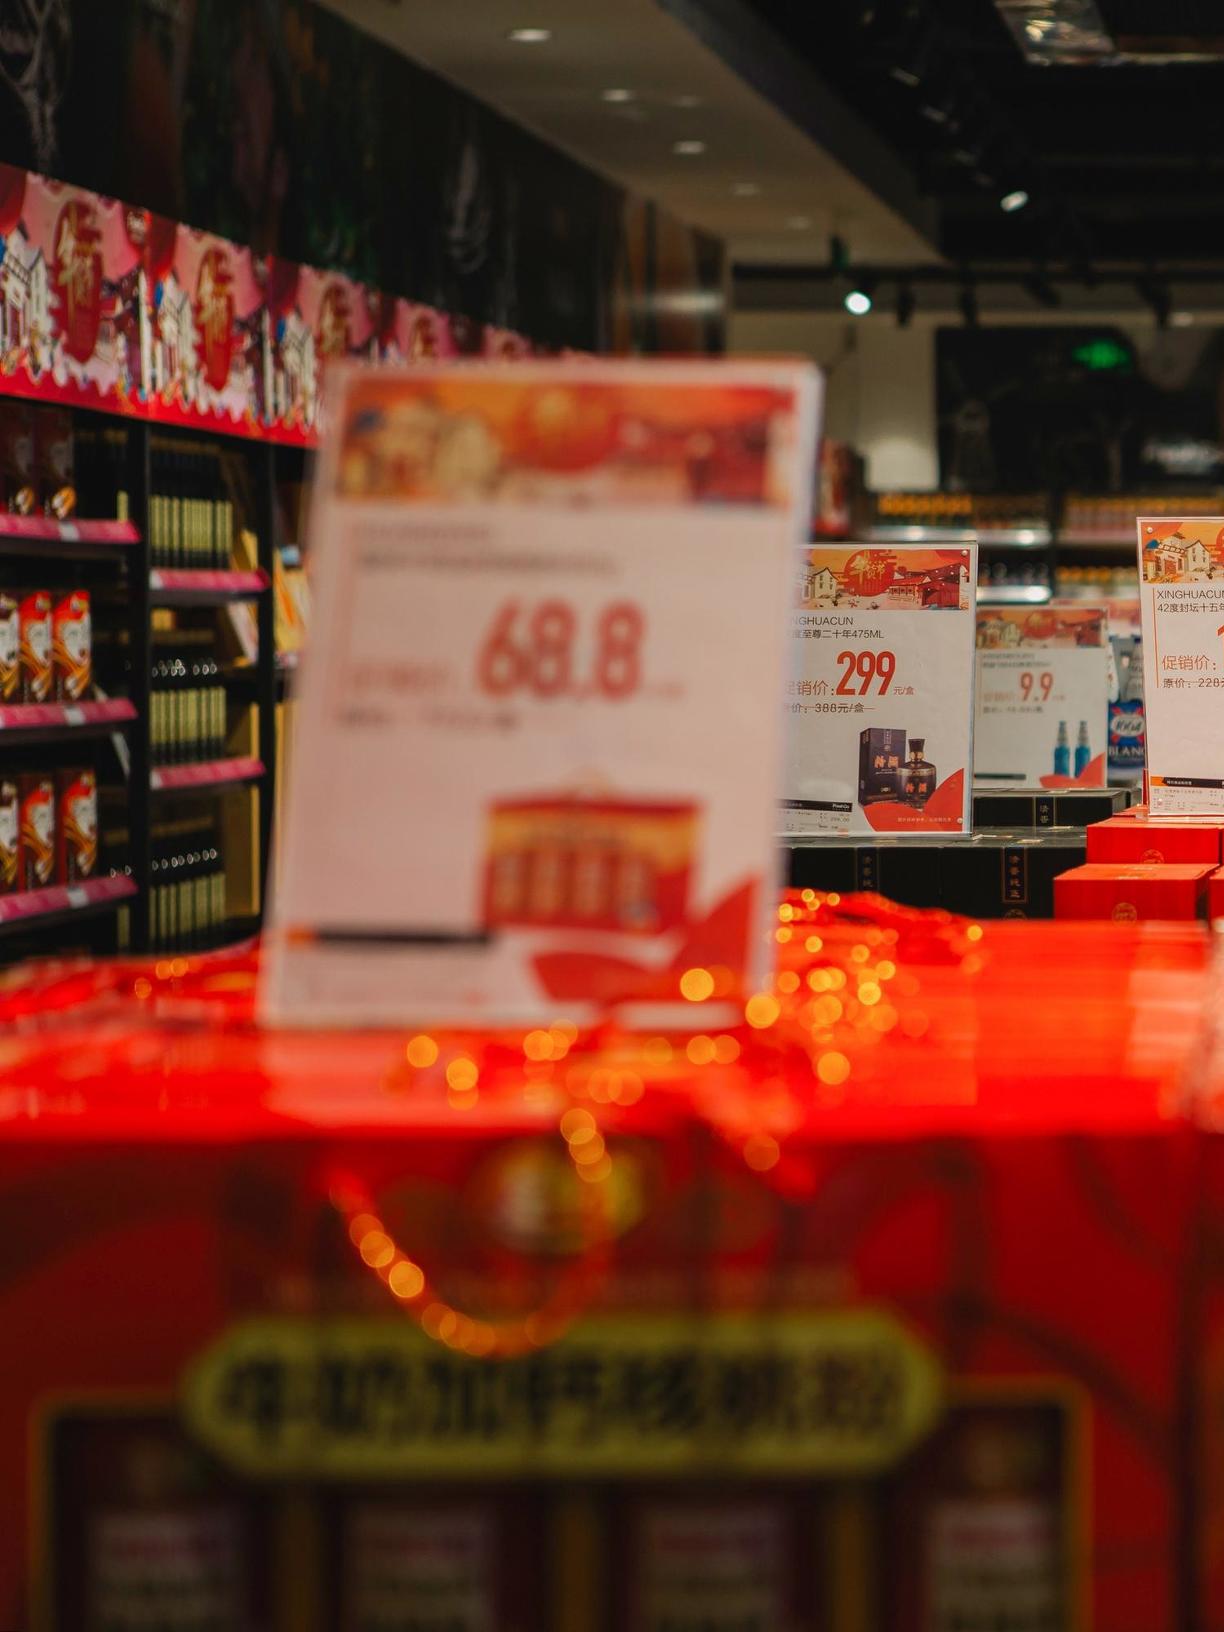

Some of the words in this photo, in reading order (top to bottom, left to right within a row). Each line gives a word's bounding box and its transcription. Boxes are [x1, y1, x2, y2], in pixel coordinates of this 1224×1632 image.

[474, 597, 648, 701] 68.8
[836, 650, 896, 696] 299
[791, 702, 865, 714] 价：388元/盒
